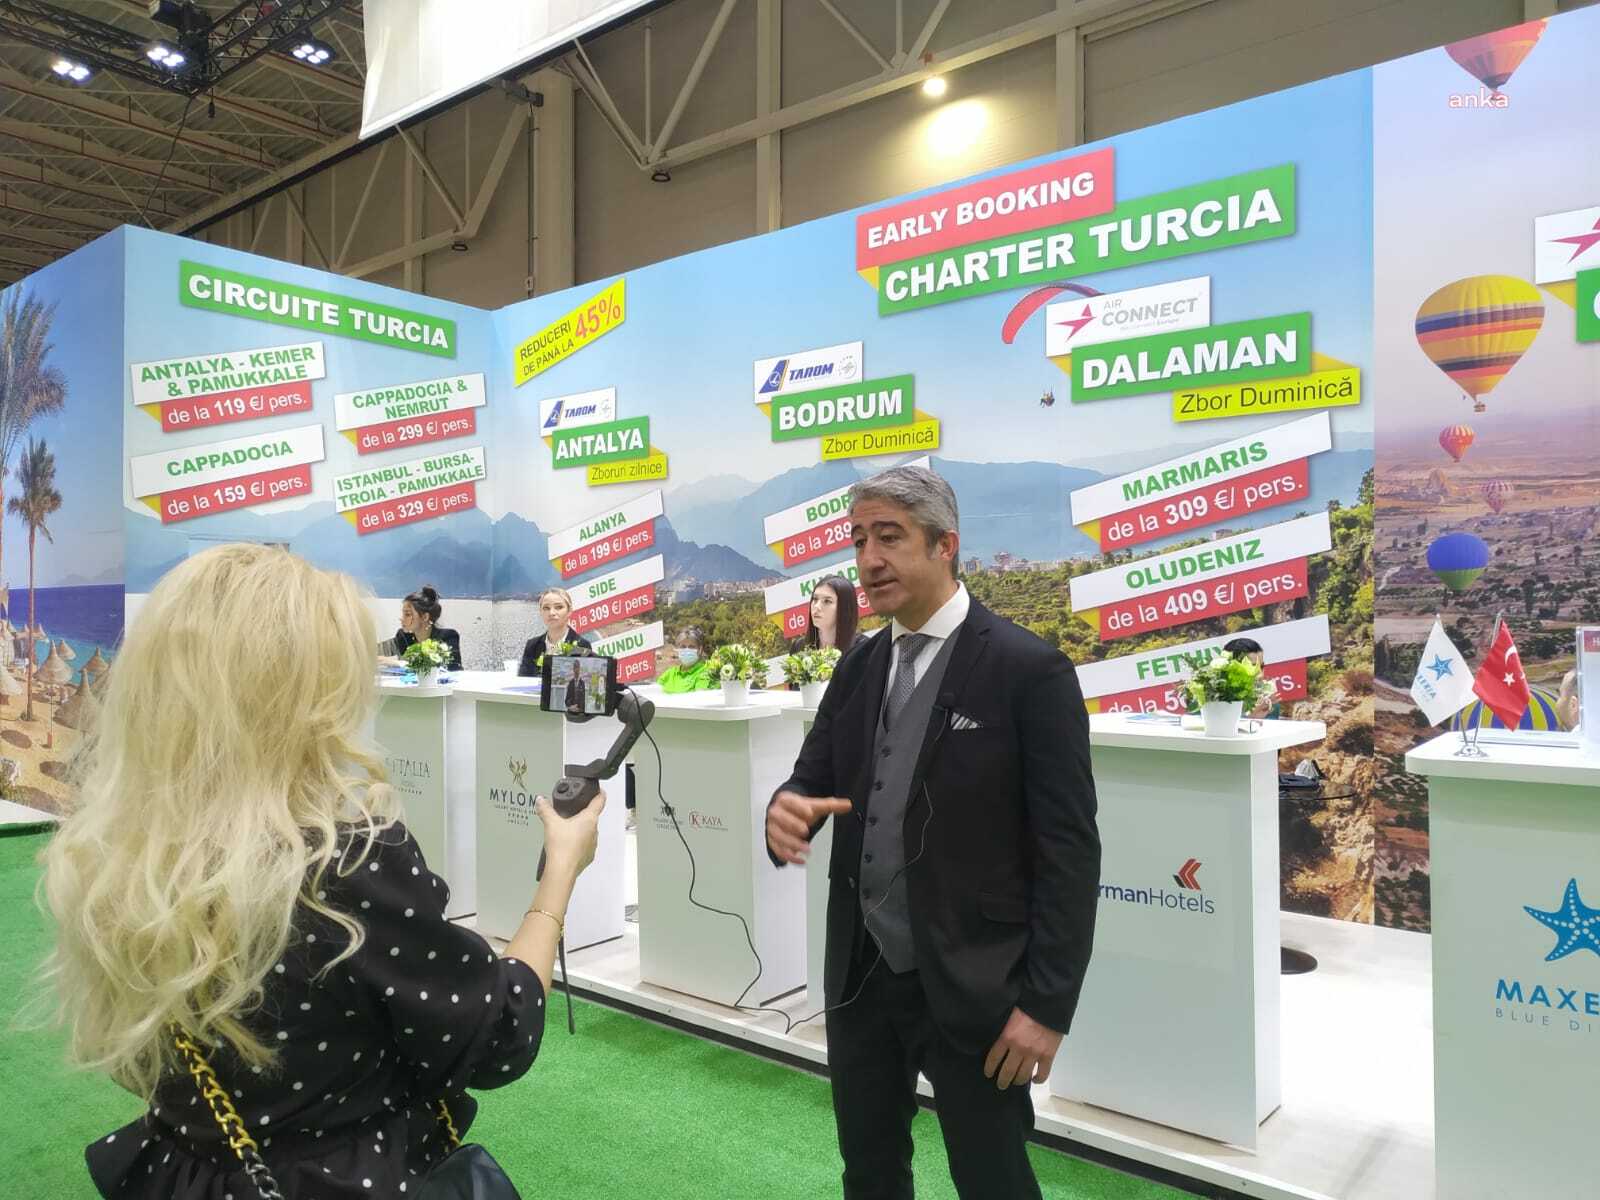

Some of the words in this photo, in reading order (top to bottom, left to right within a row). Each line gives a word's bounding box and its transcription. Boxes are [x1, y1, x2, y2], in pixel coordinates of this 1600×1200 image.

[867, 206, 945, 250] EARLY
[956, 170, 1095, 226] BOOKING
[885, 233, 1074, 303] CHARTER
[1089, 187, 1282, 258] TURCIA
[188, 273, 341, 326] CIRCUITE
[347, 307, 449, 349] TURCIA
[1102, 297, 1198, 327] CONNECT
[1104, 299, 1122, 311] AIR
[520, 320, 571, 361] REDUCERI
[575, 293, 621, 339] 45%
[140, 357, 235, 383] ANTALYA
[250, 347, 316, 368] KEMER
[523, 361, 535, 376] DE
[562, 339, 574, 353] LA
[789, 362, 834, 381] TAROM
[1081, 329, 1298, 390] DALAMAN
[167, 381, 182, 397] &
[190, 366, 308, 396] PAMUKKALE
[352, 384, 452, 410] CAPPADOCIA
[456, 380, 467, 392] &
[1180, 389, 1232, 415] Zbor
[1240, 376, 1353, 408] Duminică
[167, 408, 190, 425] de
[193, 404, 210, 421] la
[214, 400, 246, 418] 119
[269, 392, 307, 414] pers.
[385, 397, 449, 420] NEMRUT
[564, 404, 597, 419] TAROM
[778, 388, 903, 432] BODRUM
[361, 434, 380, 449] de
[382, 430, 396, 445] la
[398, 426, 424, 441] 299
[441, 417, 473, 437] pers.
[555, 427, 644, 461] ANTALYA
[825, 437, 857, 455] Zbor
[863, 426, 935, 451] Duminică
[166, 441, 293, 477] CAPPADOCIA
[1122, 441, 1269, 502] MARMARIS
[167, 498, 190, 516] de
[193, 494, 210, 511] la
[214, 485, 246, 506] 159
[269, 476, 308, 500] pers.
[336, 467, 413, 492] ISTANBUL
[337, 488, 386, 508] TROIA
[398, 465, 485, 496] PAMUKKALE
[361, 513, 380, 529] de
[382, 509, 396, 525] la
[398, 503, 424, 519] 329
[441, 493, 473, 514] pers.
[806, 494, 852, 522] BODR
[1107, 519, 1134, 542] de
[1139, 513, 1159, 535] la
[1163, 495, 1209, 526] 309
[1243, 474, 1303, 506] pers.
[579, 511, 627, 542] ALANYA
[788, 540, 806, 558] de
[808, 535, 822, 551] la
[824, 521, 852, 546] 289
[565, 558, 577, 572] de
[579, 553, 588, 566] la
[590, 542, 610, 560] 199
[626, 529, 652, 550] pers.
[1125, 538, 1265, 590] OLUDENIZ
[589, 577, 617, 599] SIDE
[1107, 608, 1134, 631] de
[1139, 602, 1159, 624] la
[1163, 588, 1208, 616] 409
[1243, 571, 1303, 601] pers.
[579, 613, 588, 626] la
[589, 605, 610, 623] 309
[788, 612, 806, 630] de
[597, 633, 645, 657] KUNDU
[625, 660, 652, 679] pers.
[1099, 884, 1215, 914] rmanHotels
[1495, 978, 1600, 1015] MAXE
[1495, 1007, 1549, 1026] BLUE
[1569, 1020, 1592, 1033] DI
